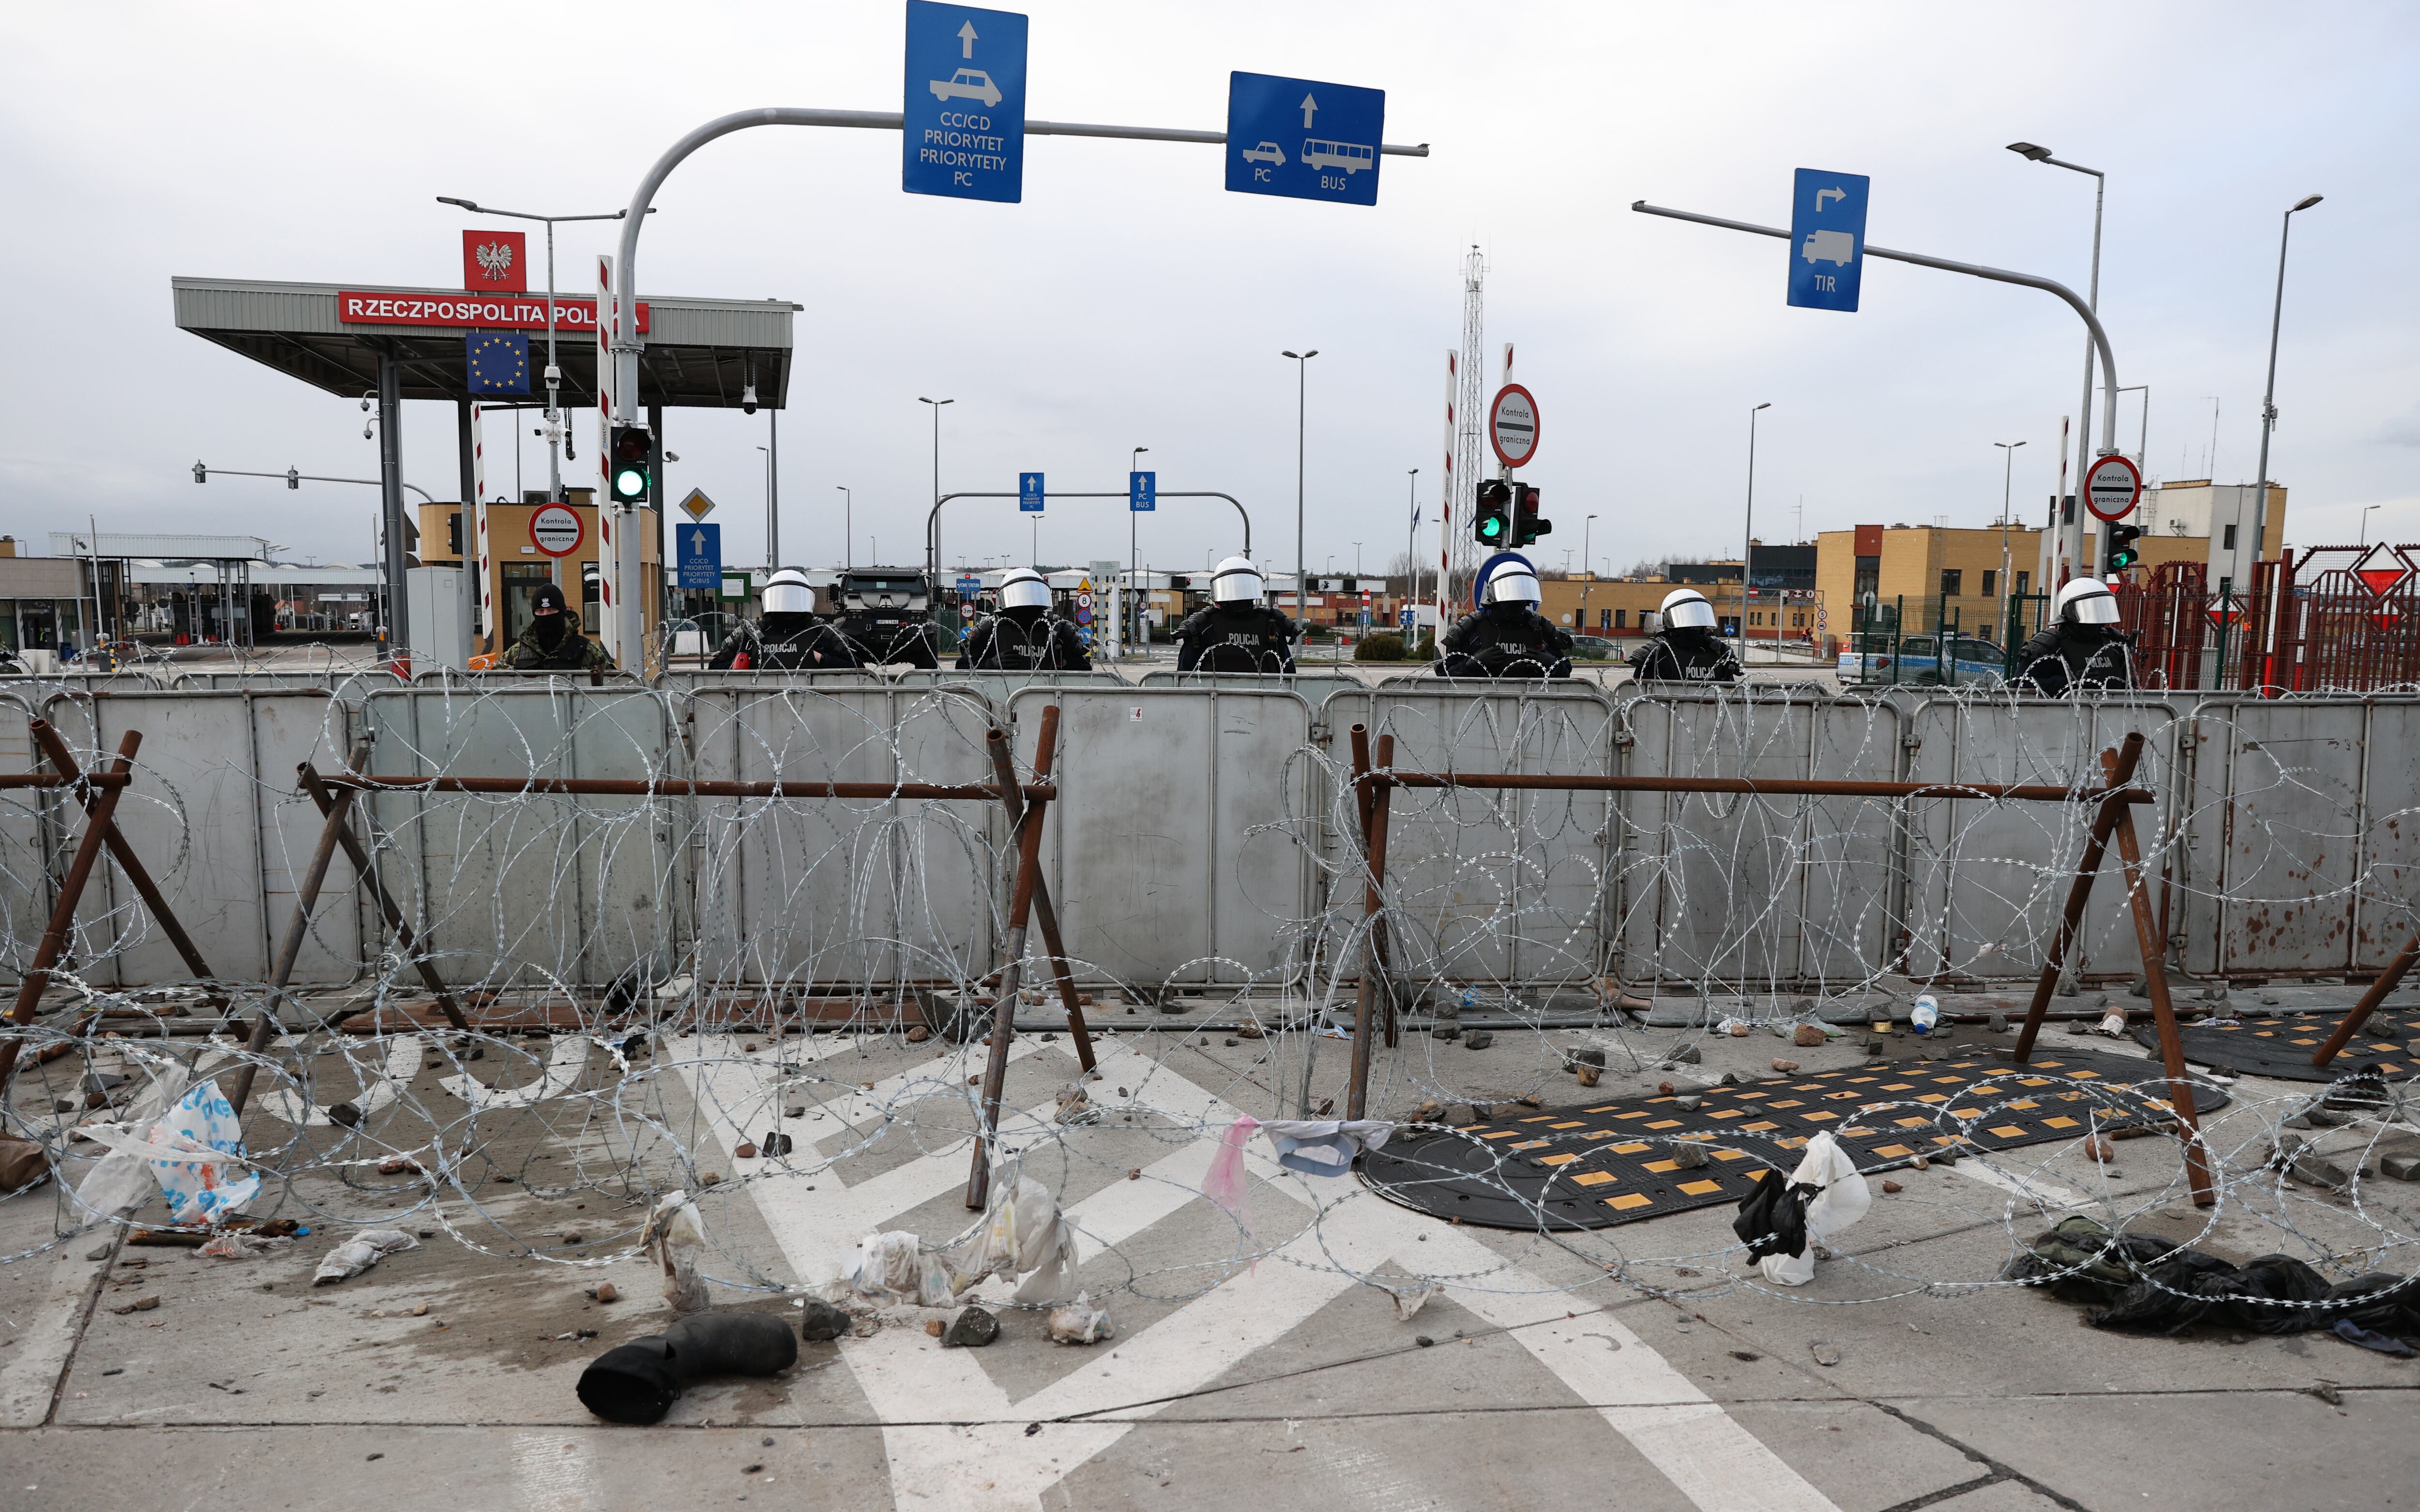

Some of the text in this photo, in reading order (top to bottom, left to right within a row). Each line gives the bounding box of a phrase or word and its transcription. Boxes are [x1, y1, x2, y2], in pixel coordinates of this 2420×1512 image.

[940, 112, 990, 130] CC/CD
[925, 129, 1004, 151] PRIORYTET
[920, 148, 1007, 171] PRIORYTETY
[954, 171, 972, 186] PC
[1255, 168, 1270, 182] PC
[1321, 176, 1346, 191] BUS
[1815, 275, 1835, 292] TIR
[348, 299, 640, 326] RZECZPOSPOLITA POL
[1501, 406, 1529, 419] Kontrola
[1499, 435, 1530, 446] graniczna
[2094, 495, 2129, 504] graniczna
[1228, 633, 1259, 645] POLICJA
[763, 644, 797, 653] POLICJA
[1496, 642, 1527, 654] OLICJA
[2085, 657, 2113, 668] POLICJA
